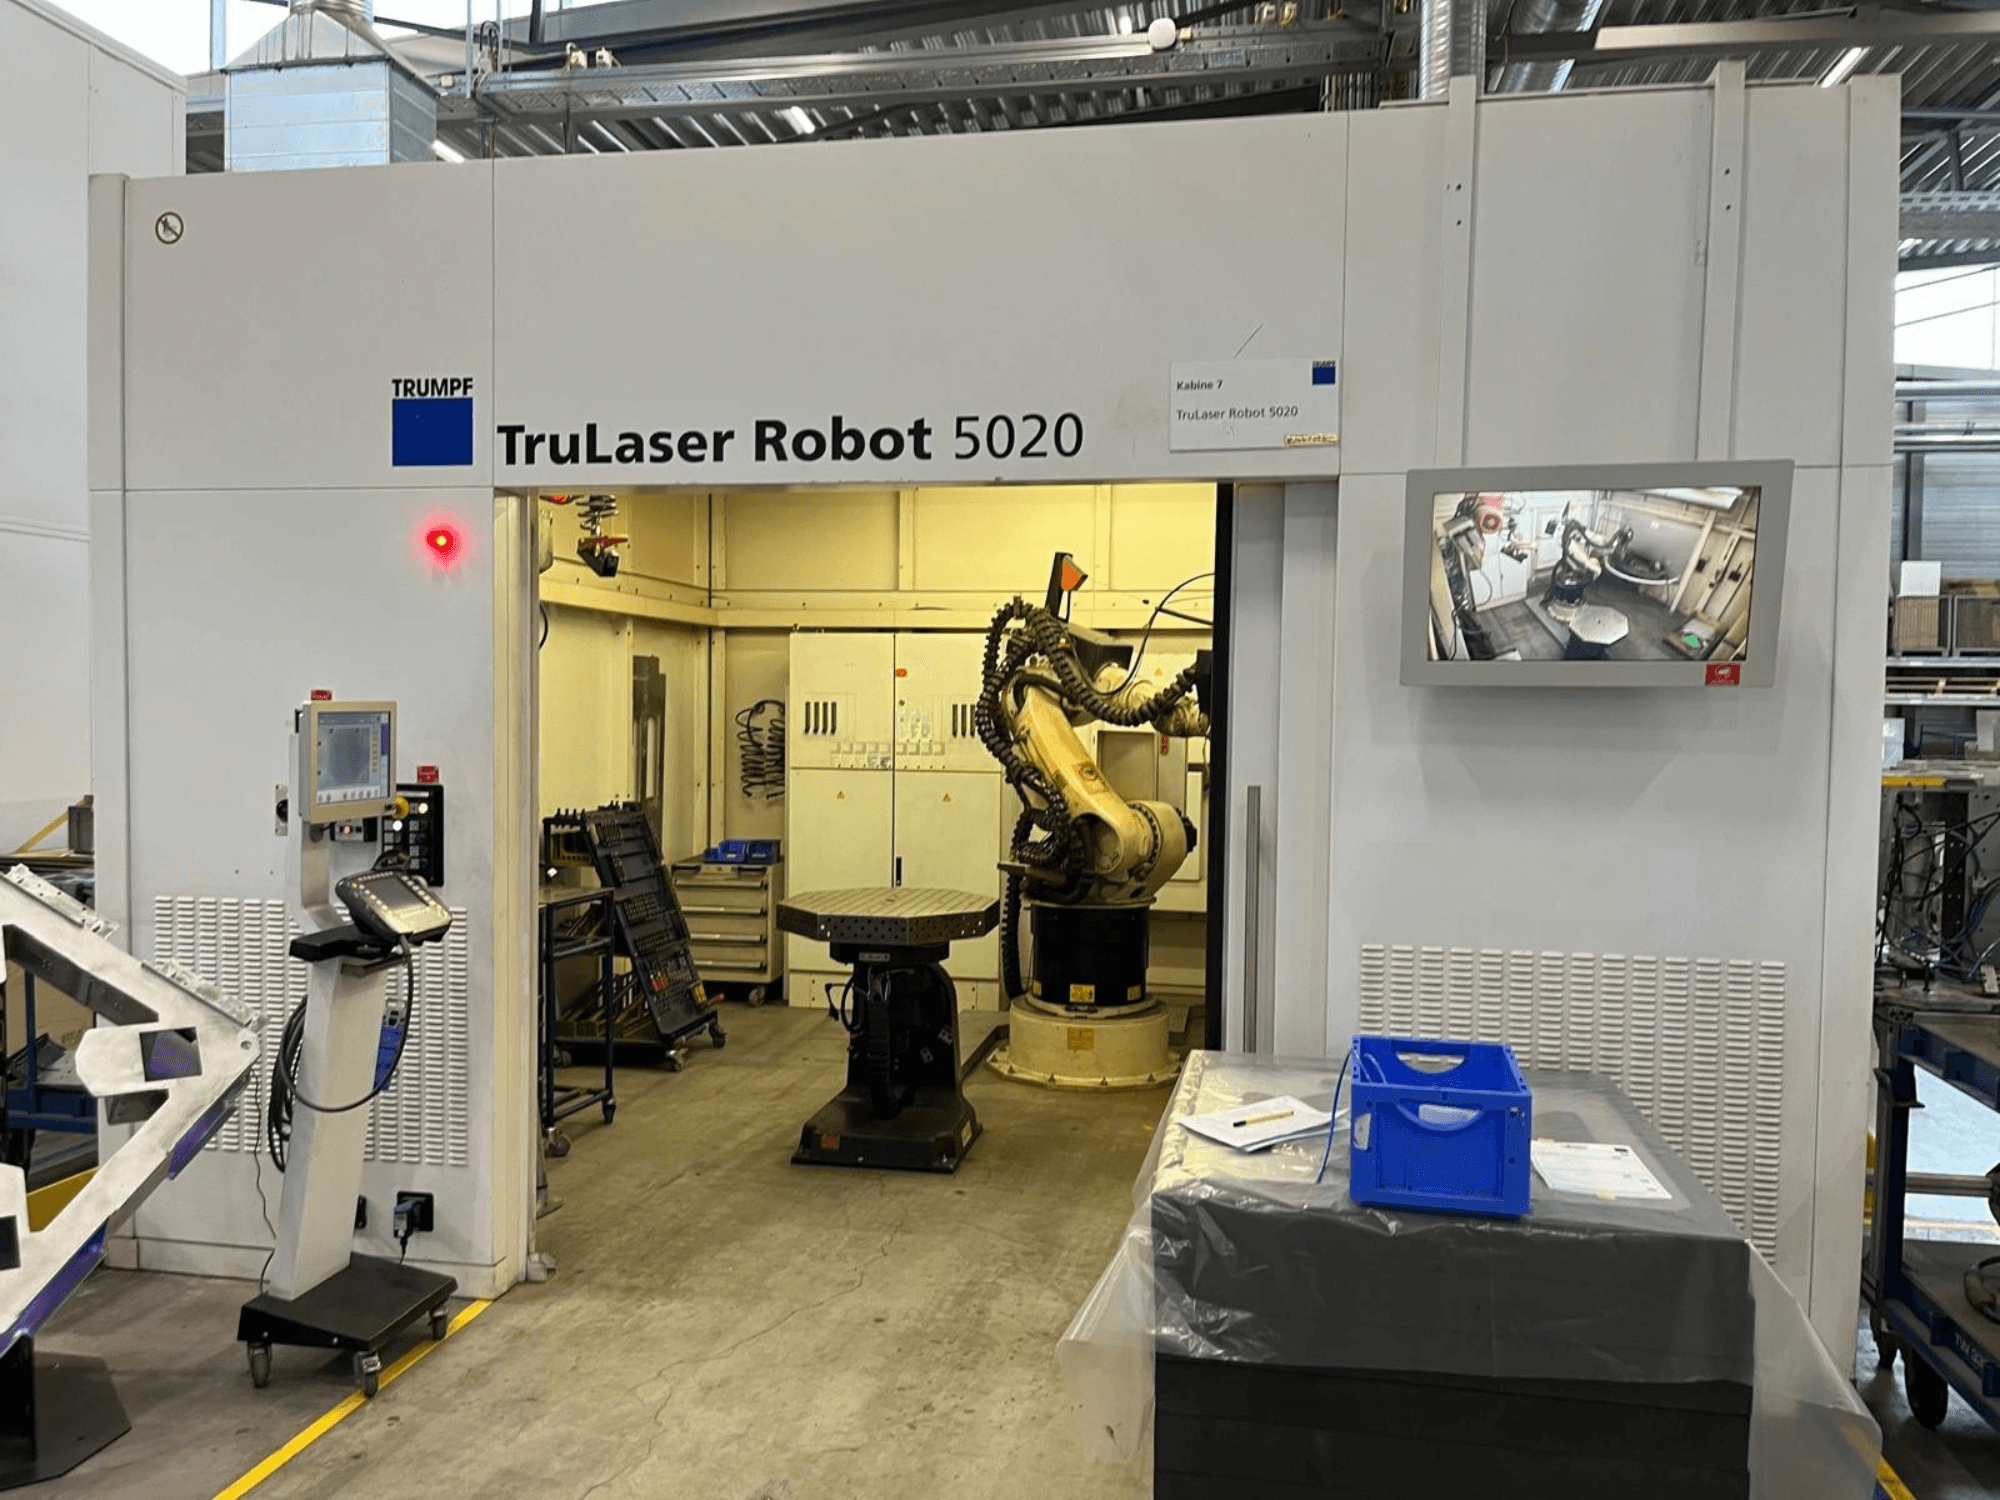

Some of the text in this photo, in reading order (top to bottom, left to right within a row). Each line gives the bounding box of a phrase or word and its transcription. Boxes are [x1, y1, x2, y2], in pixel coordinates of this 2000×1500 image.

[392, 378, 474, 396] TRUMPF
[1176, 379, 1223, 391] Kabine 7
[1176, 405, 1299, 421] TruLaser Robot 5020
[497, 412, 1084, 465] TruLaser Robot 5020
